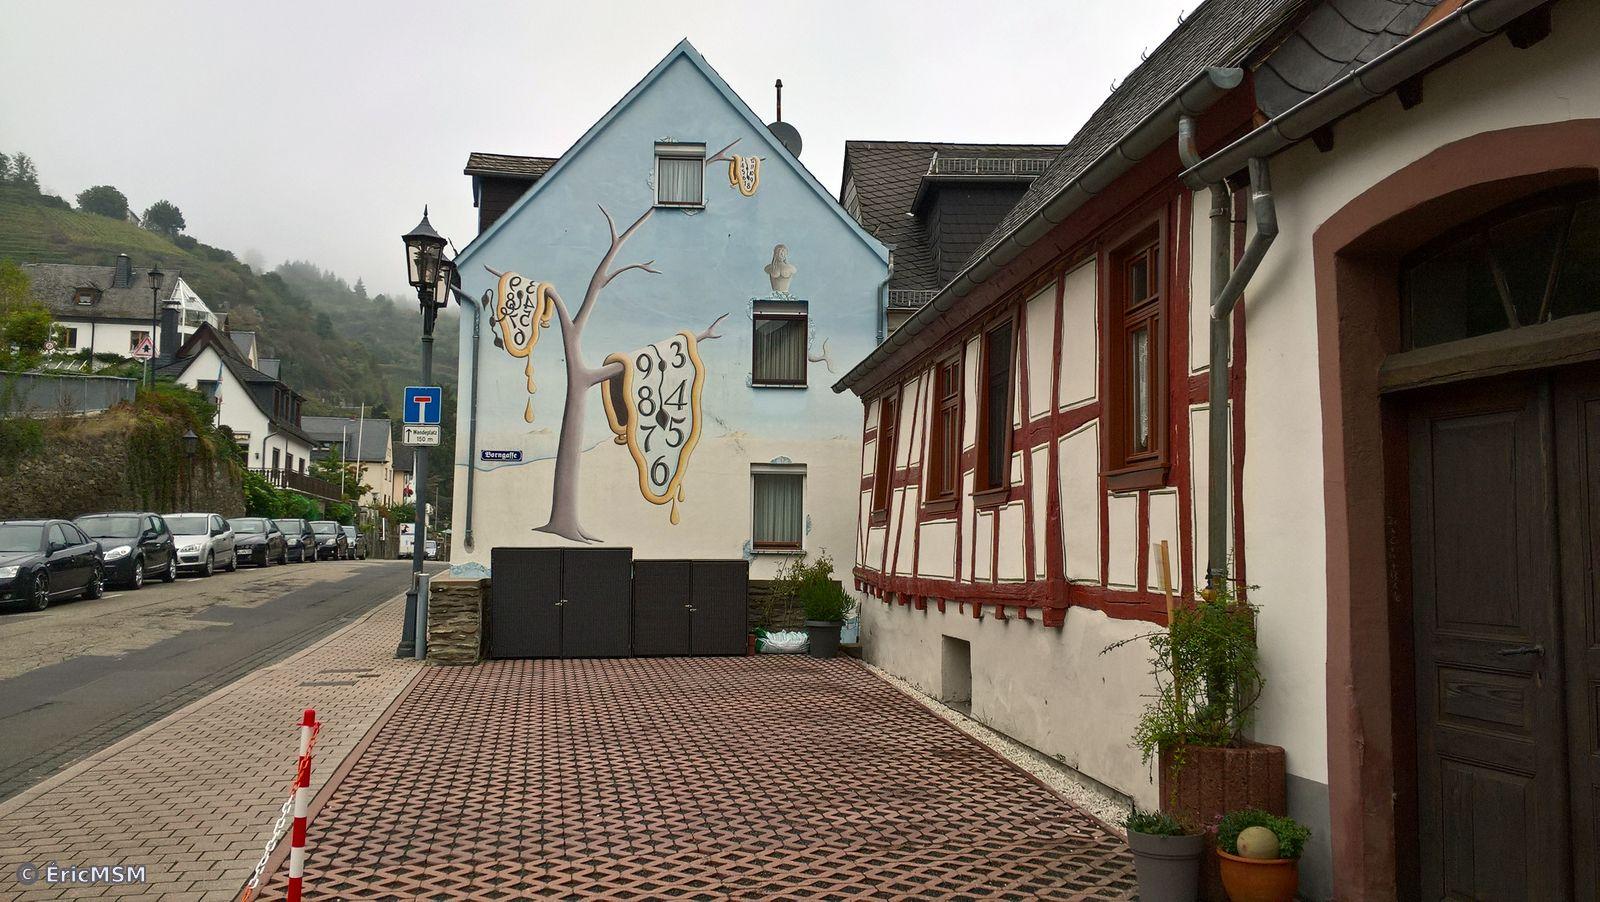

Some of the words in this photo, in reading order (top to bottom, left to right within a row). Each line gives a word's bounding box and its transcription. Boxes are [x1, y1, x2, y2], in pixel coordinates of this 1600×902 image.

[635, 353, 653, 380] 9
[670, 341, 686, 369] 3
[637, 386, 656, 416] 8
[664, 379, 688, 411] 4
[640, 425, 657, 453] 7
[665, 417, 686, 447] 5
[650, 455, 670, 486] 6
